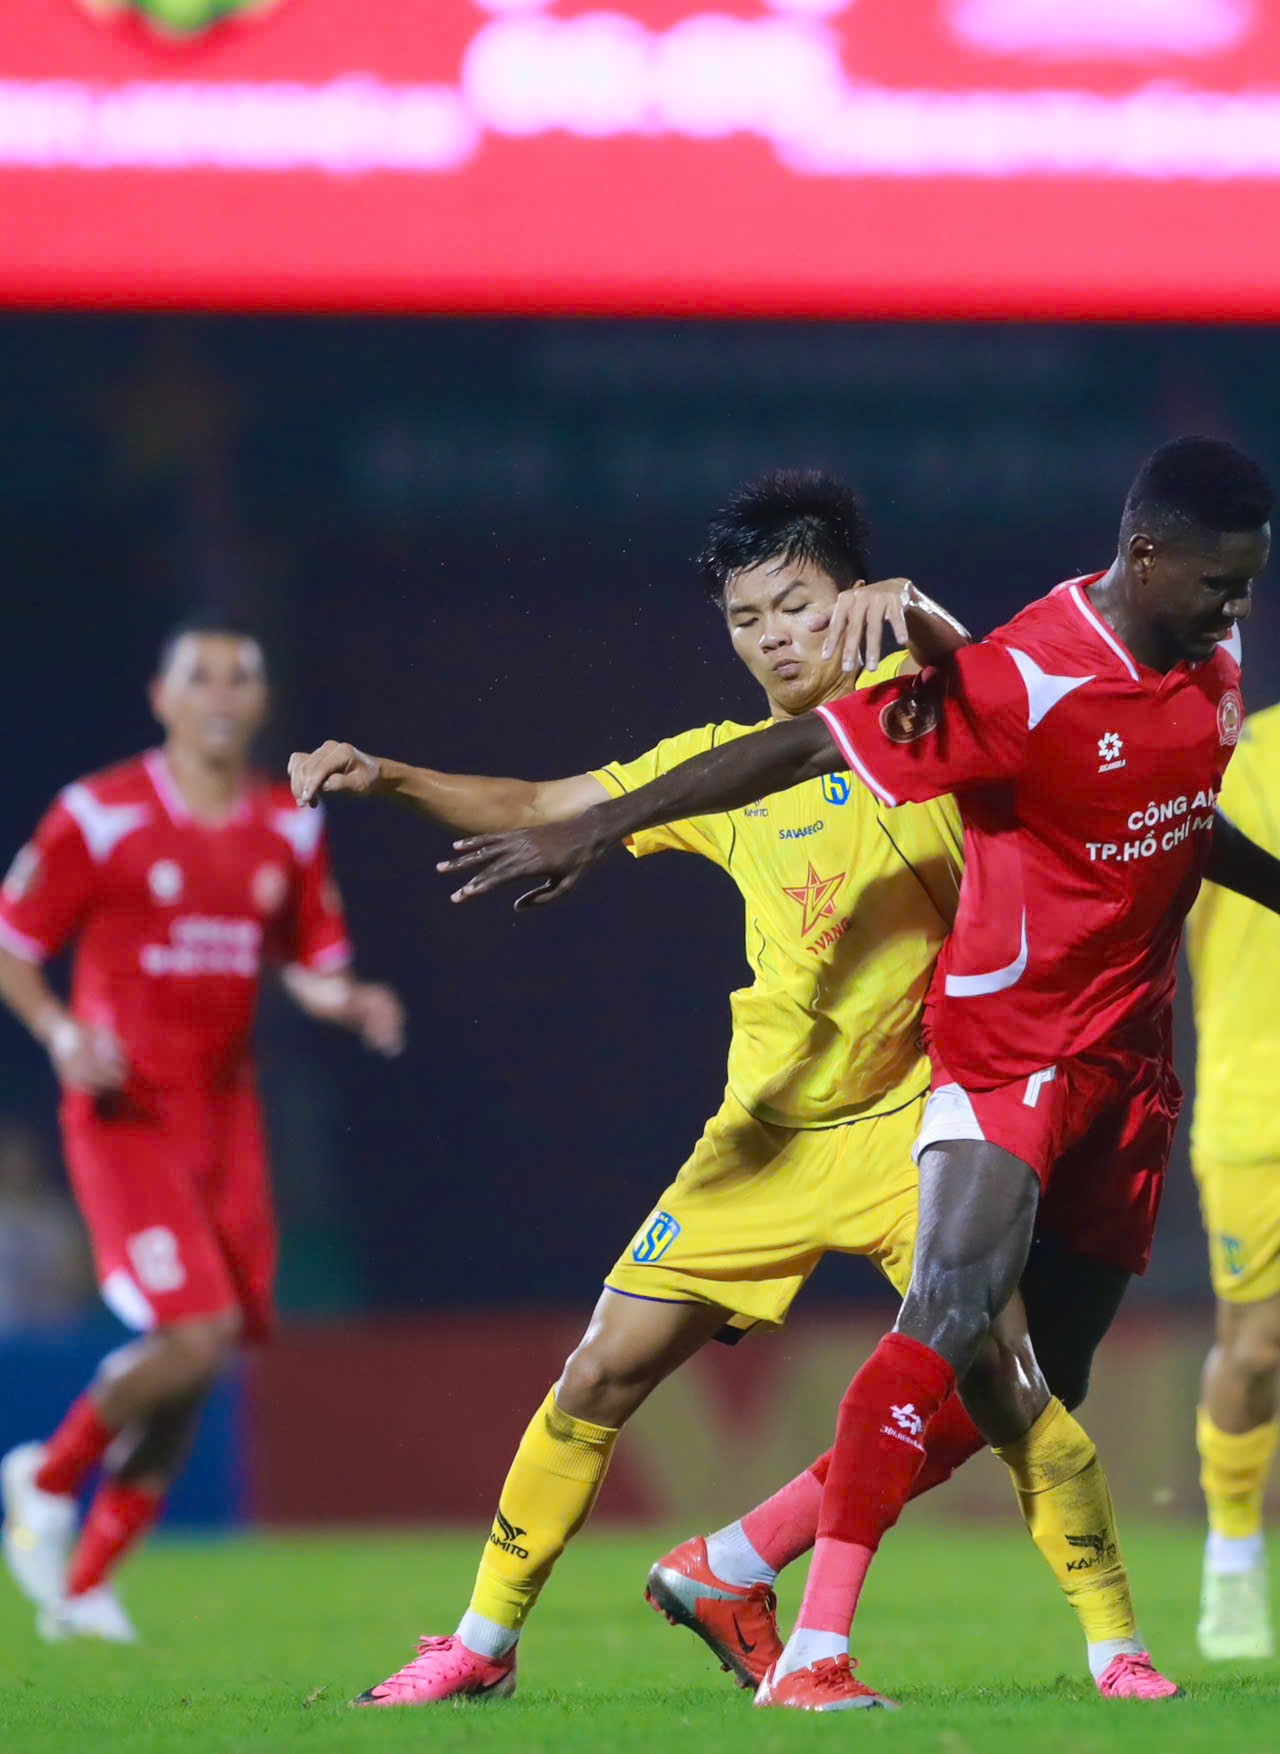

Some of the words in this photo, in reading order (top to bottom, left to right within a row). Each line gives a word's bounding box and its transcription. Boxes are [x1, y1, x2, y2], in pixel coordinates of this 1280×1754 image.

[1127, 795, 1188, 831] CÔNG
[1161, 814, 1193, 852] CHÍ
[490, 1533, 529, 1560] AMITO
